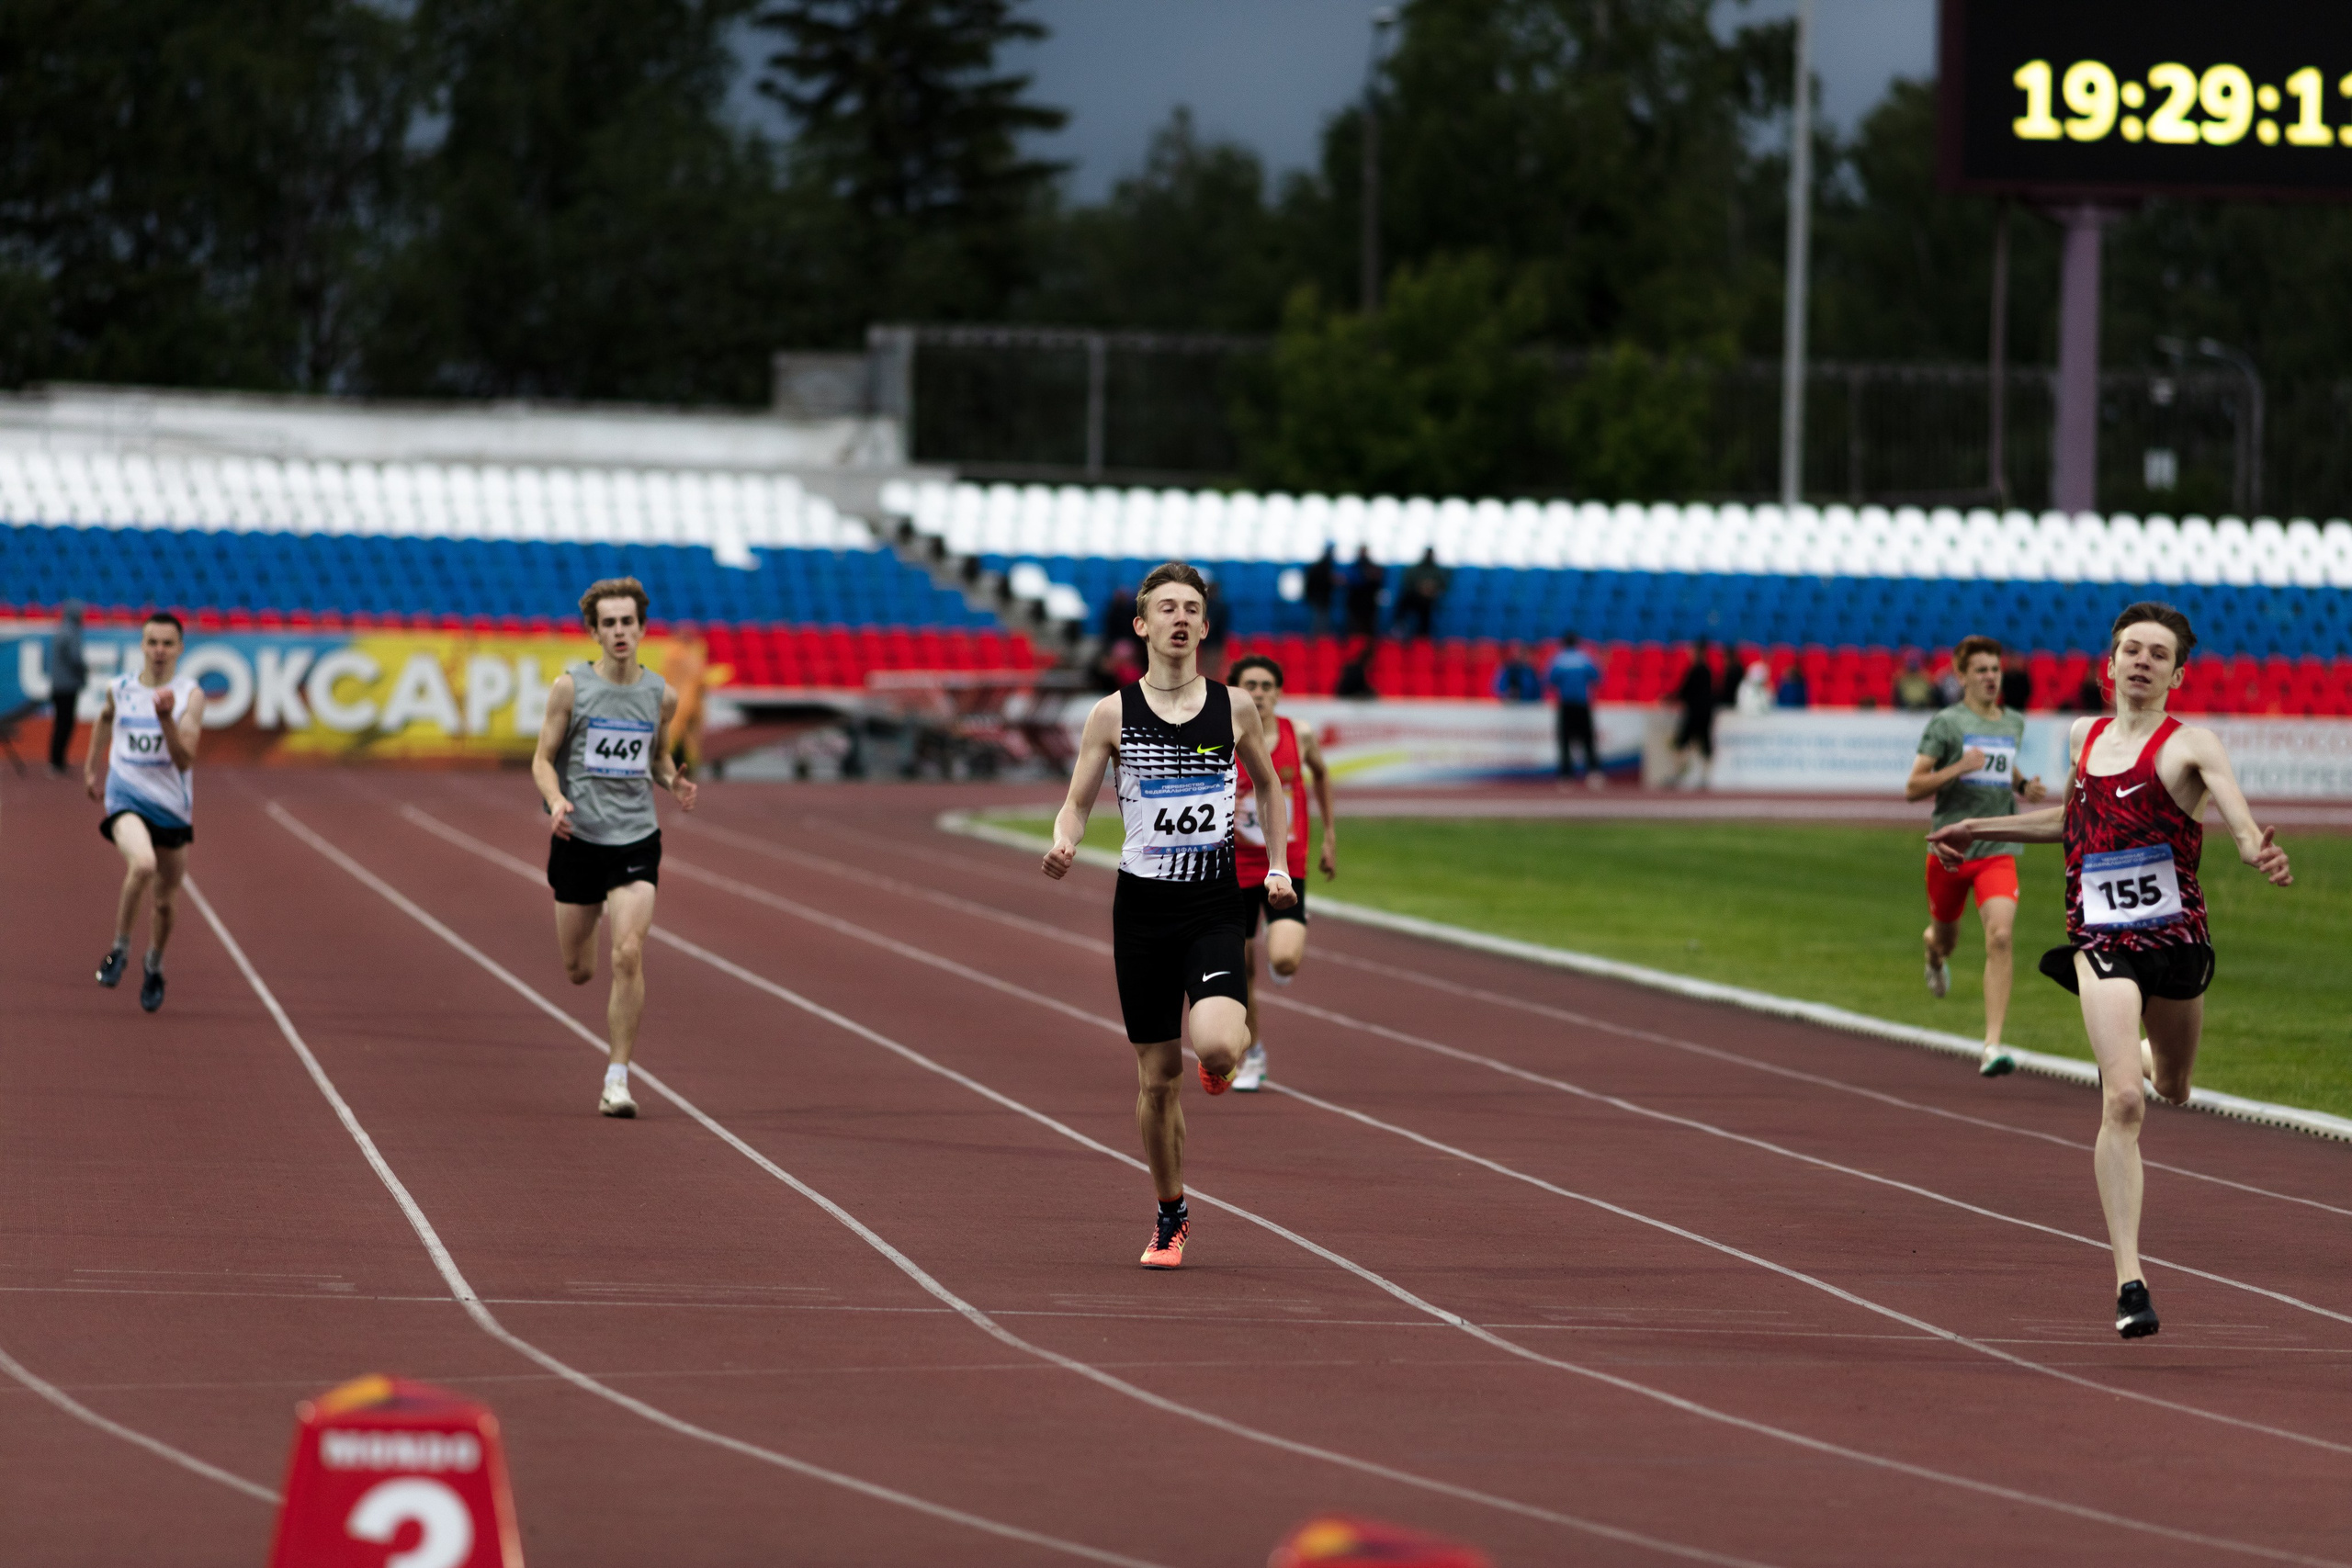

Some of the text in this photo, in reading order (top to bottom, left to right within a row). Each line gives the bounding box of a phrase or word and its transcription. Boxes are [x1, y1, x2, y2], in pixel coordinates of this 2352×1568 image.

[2012, 59, 2352, 148] 19:29:1
[594, 737, 643, 761] 449
[1984, 753, 2007, 773] 78
[1161, 782, 1205, 790] ПЕРВЕНСТВО
[1153, 803, 1216, 836] 462
[2098, 874, 2163, 910] 155
